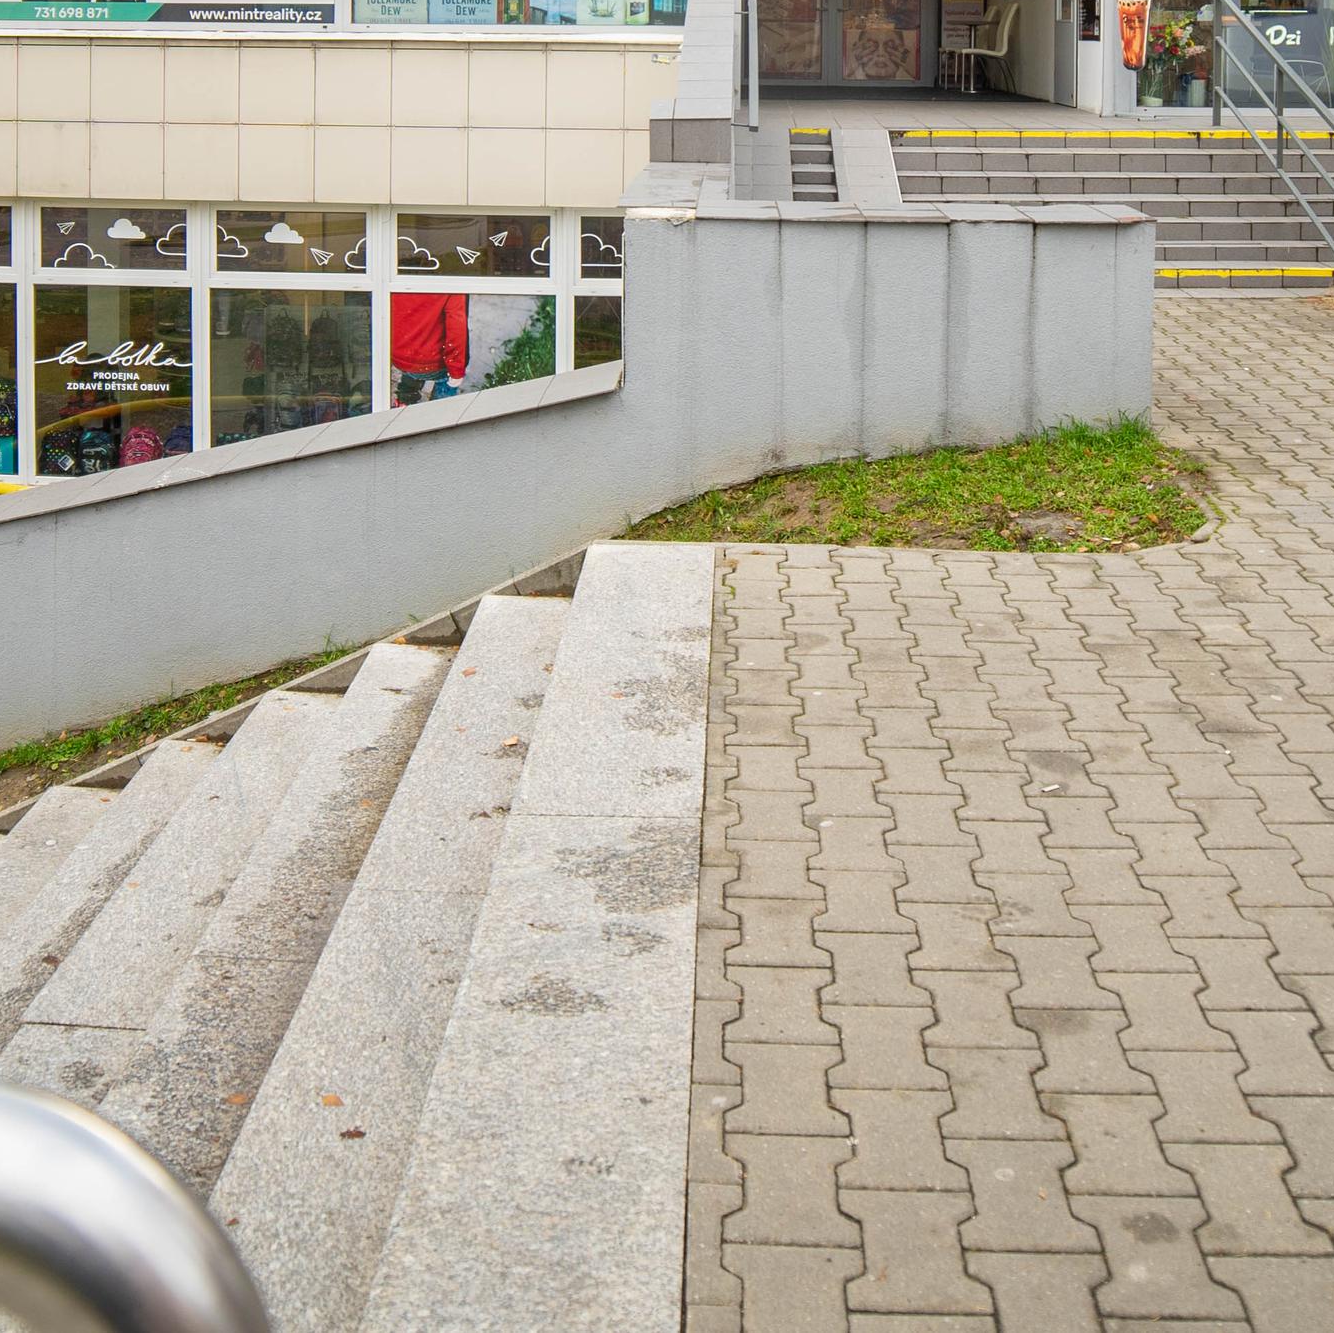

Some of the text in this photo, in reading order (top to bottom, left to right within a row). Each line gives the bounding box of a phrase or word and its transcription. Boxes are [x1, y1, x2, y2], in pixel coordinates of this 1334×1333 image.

[34, 6, 110, 19] 731 698 871
[189, 8, 323, 23] www.mintreality.cz
[380, 5, 402, 16] DEW
[455, 5, 477, 16] DEW
[106, 341, 193, 367] botka
[93, 371, 140, 381] PRODEJNA
[66, 380, 170, 392] ZDRAVÉ DĚTSKÉ OBUVI
